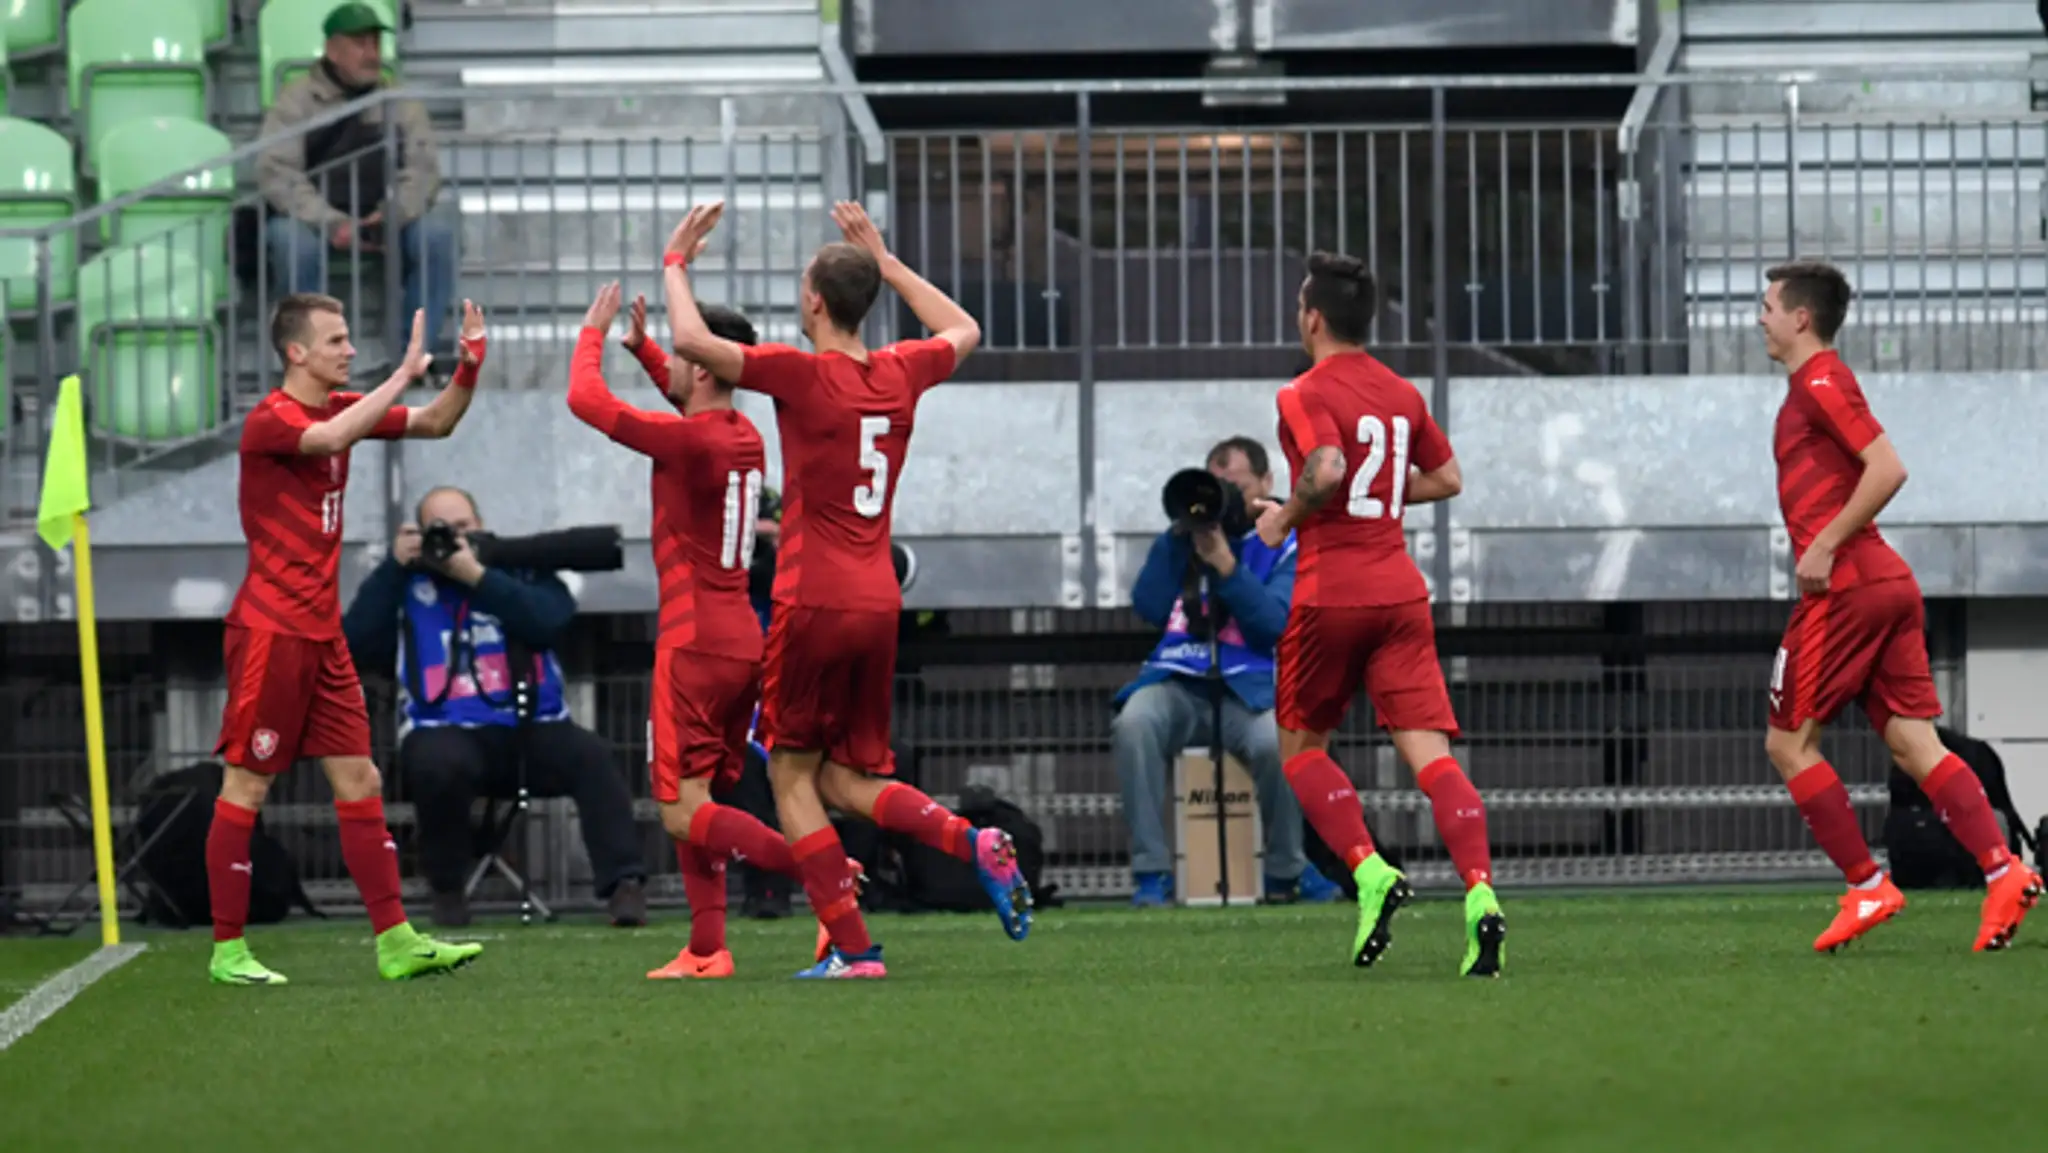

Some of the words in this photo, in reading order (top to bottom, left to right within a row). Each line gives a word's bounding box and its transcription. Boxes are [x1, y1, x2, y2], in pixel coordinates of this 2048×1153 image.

[853, 415, 891, 517] 5
[1346, 414, 1409, 519] 21
[1188, 788, 1251, 805] Nion
